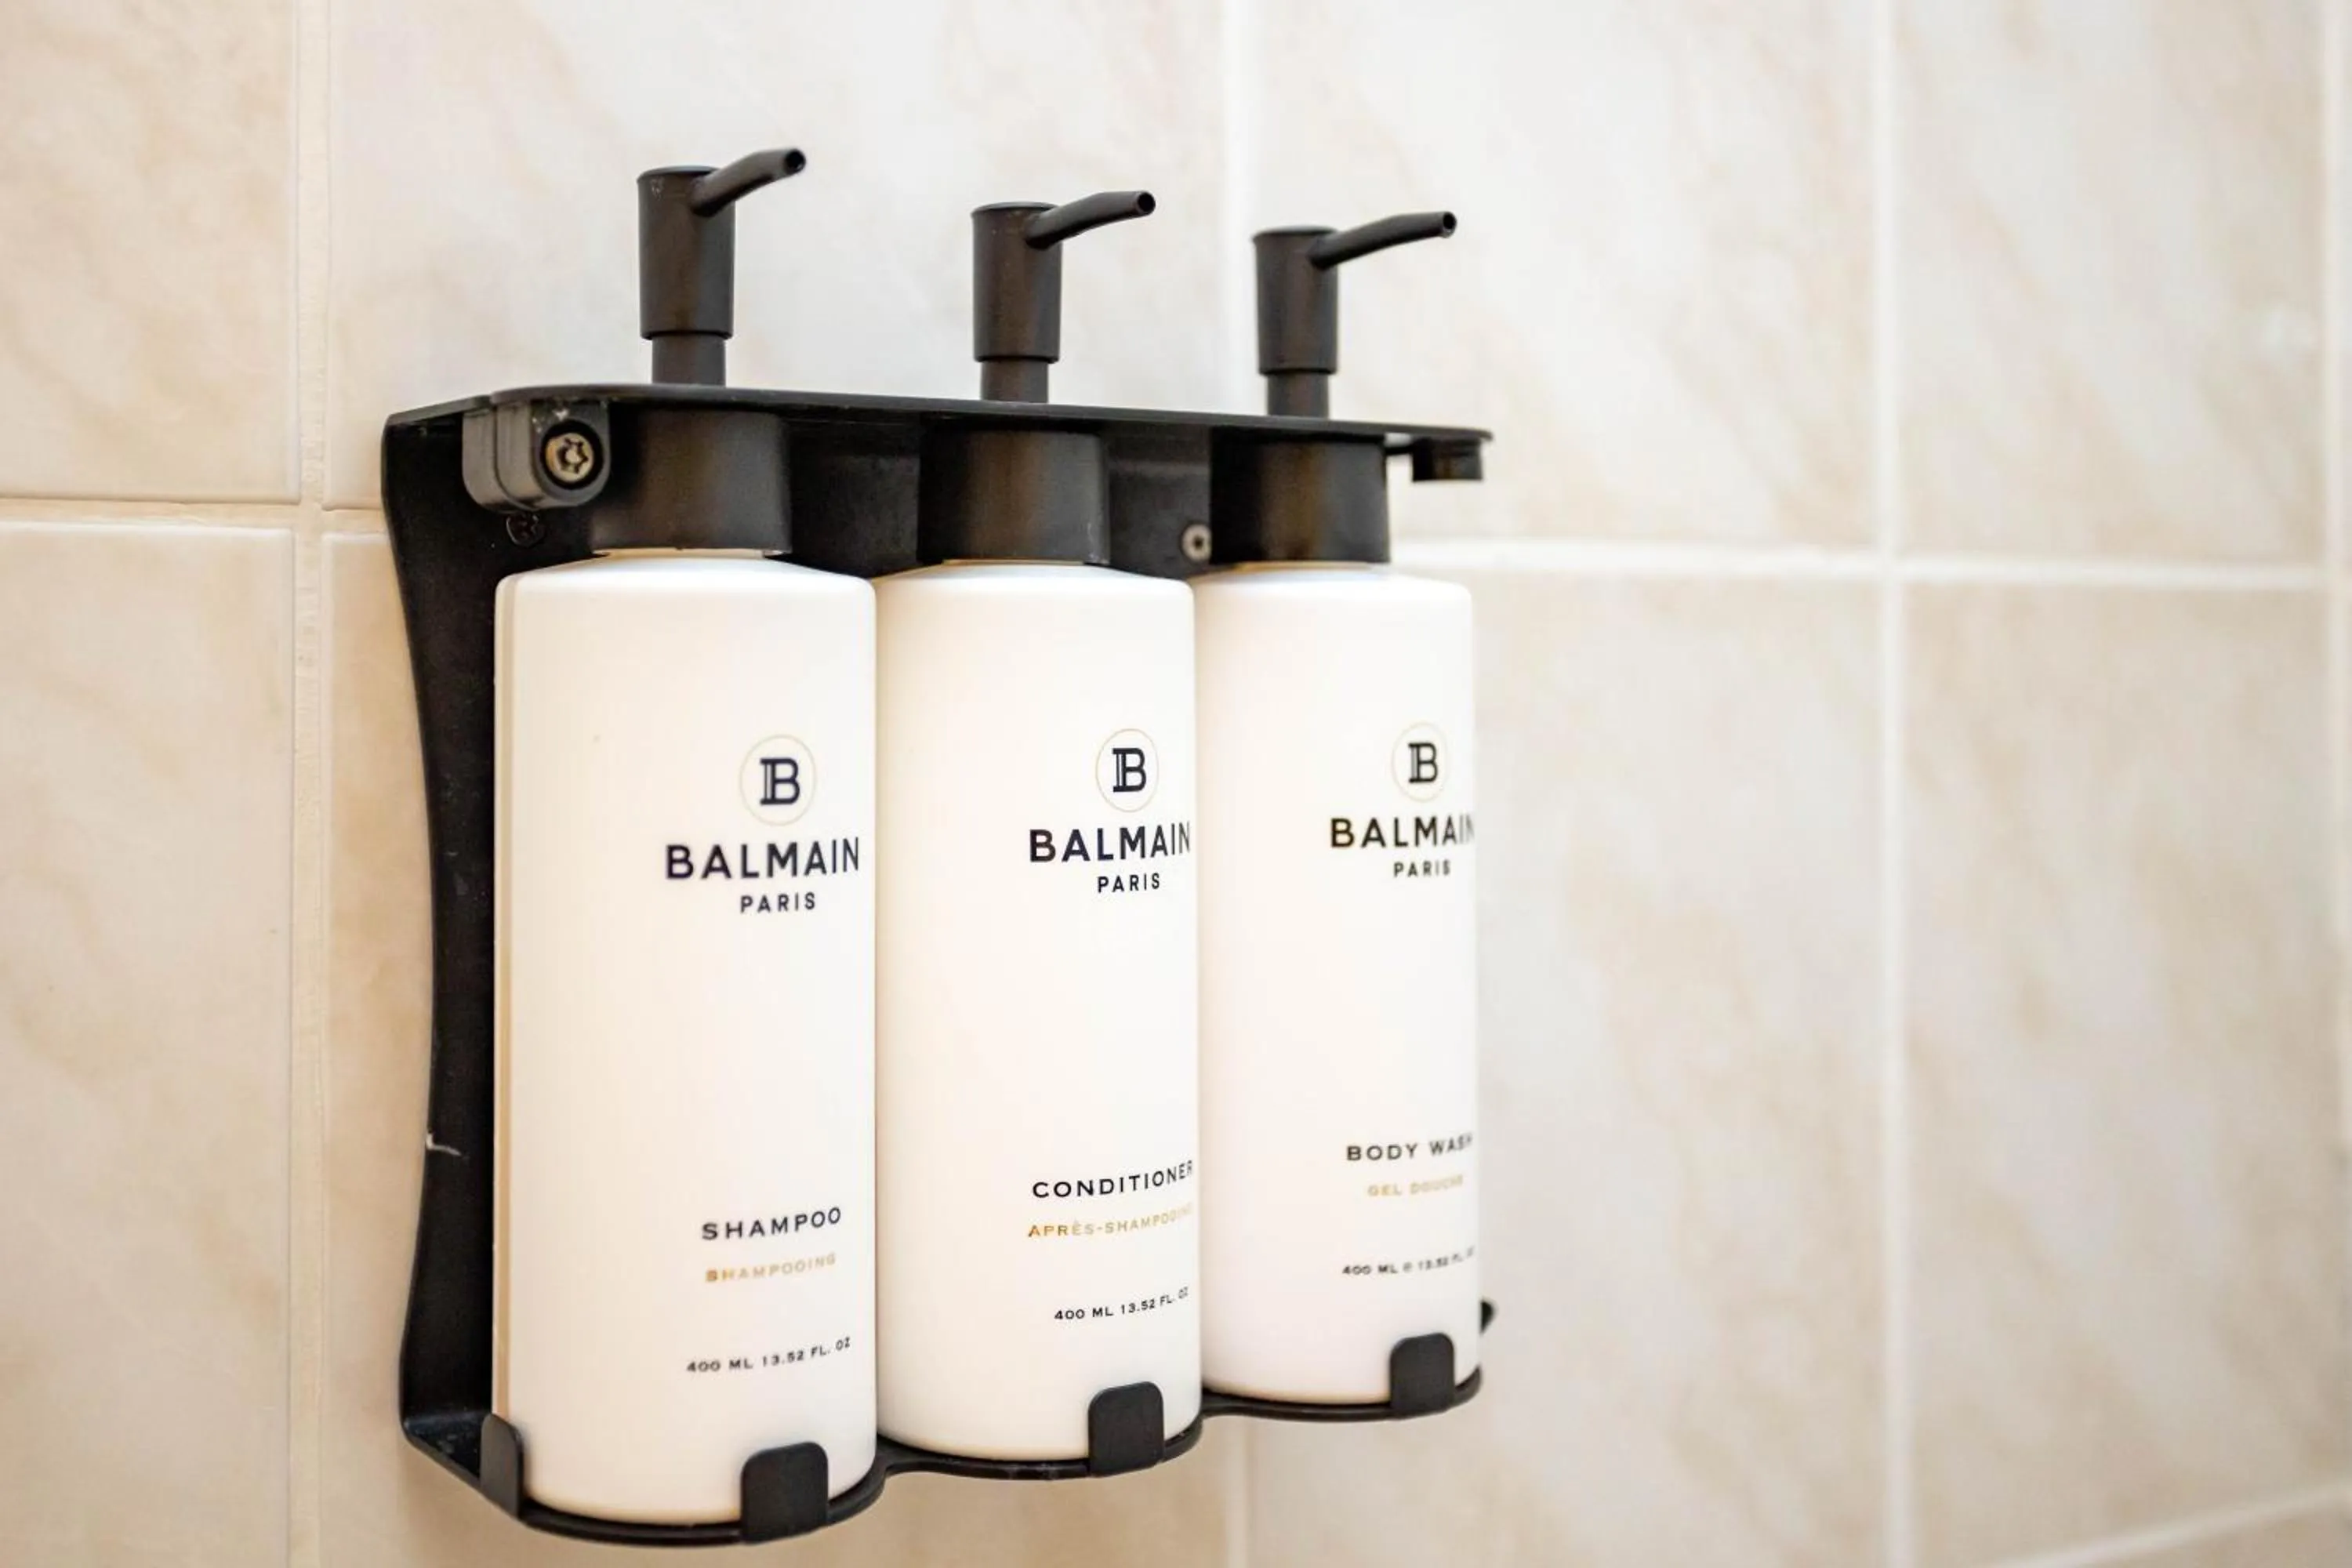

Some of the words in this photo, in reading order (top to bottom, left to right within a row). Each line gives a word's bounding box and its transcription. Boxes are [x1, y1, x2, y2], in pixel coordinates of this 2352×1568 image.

[1029, 821, 1191, 862] BALMAIN
[1330, 813, 1475, 848] BALMAIN
[666, 837, 859, 879] BALMAIN
[1393, 859, 1451, 878] PARIS
[1098, 873, 1160, 893] PARIS
[740, 891, 816, 913] PARIS
[1346, 1142, 1418, 1161] BODY
[1032, 1160, 1192, 1198] CONDITIONER
[1367, 1184, 1403, 1196] GEL
[702, 1207, 842, 1240] SHAMPOO
[1342, 1265, 1372, 1275] 400
[1377, 1265, 1399, 1274] ML
[1054, 1308, 1085, 1320] 400
[1092, 1307, 1113, 1318] ML
[1120, 1298, 1156, 1315] 13.52
[686, 1360, 721, 1373] 400
[728, 1359, 753, 1370] ML
[763, 1350, 805, 1367] 13.52
